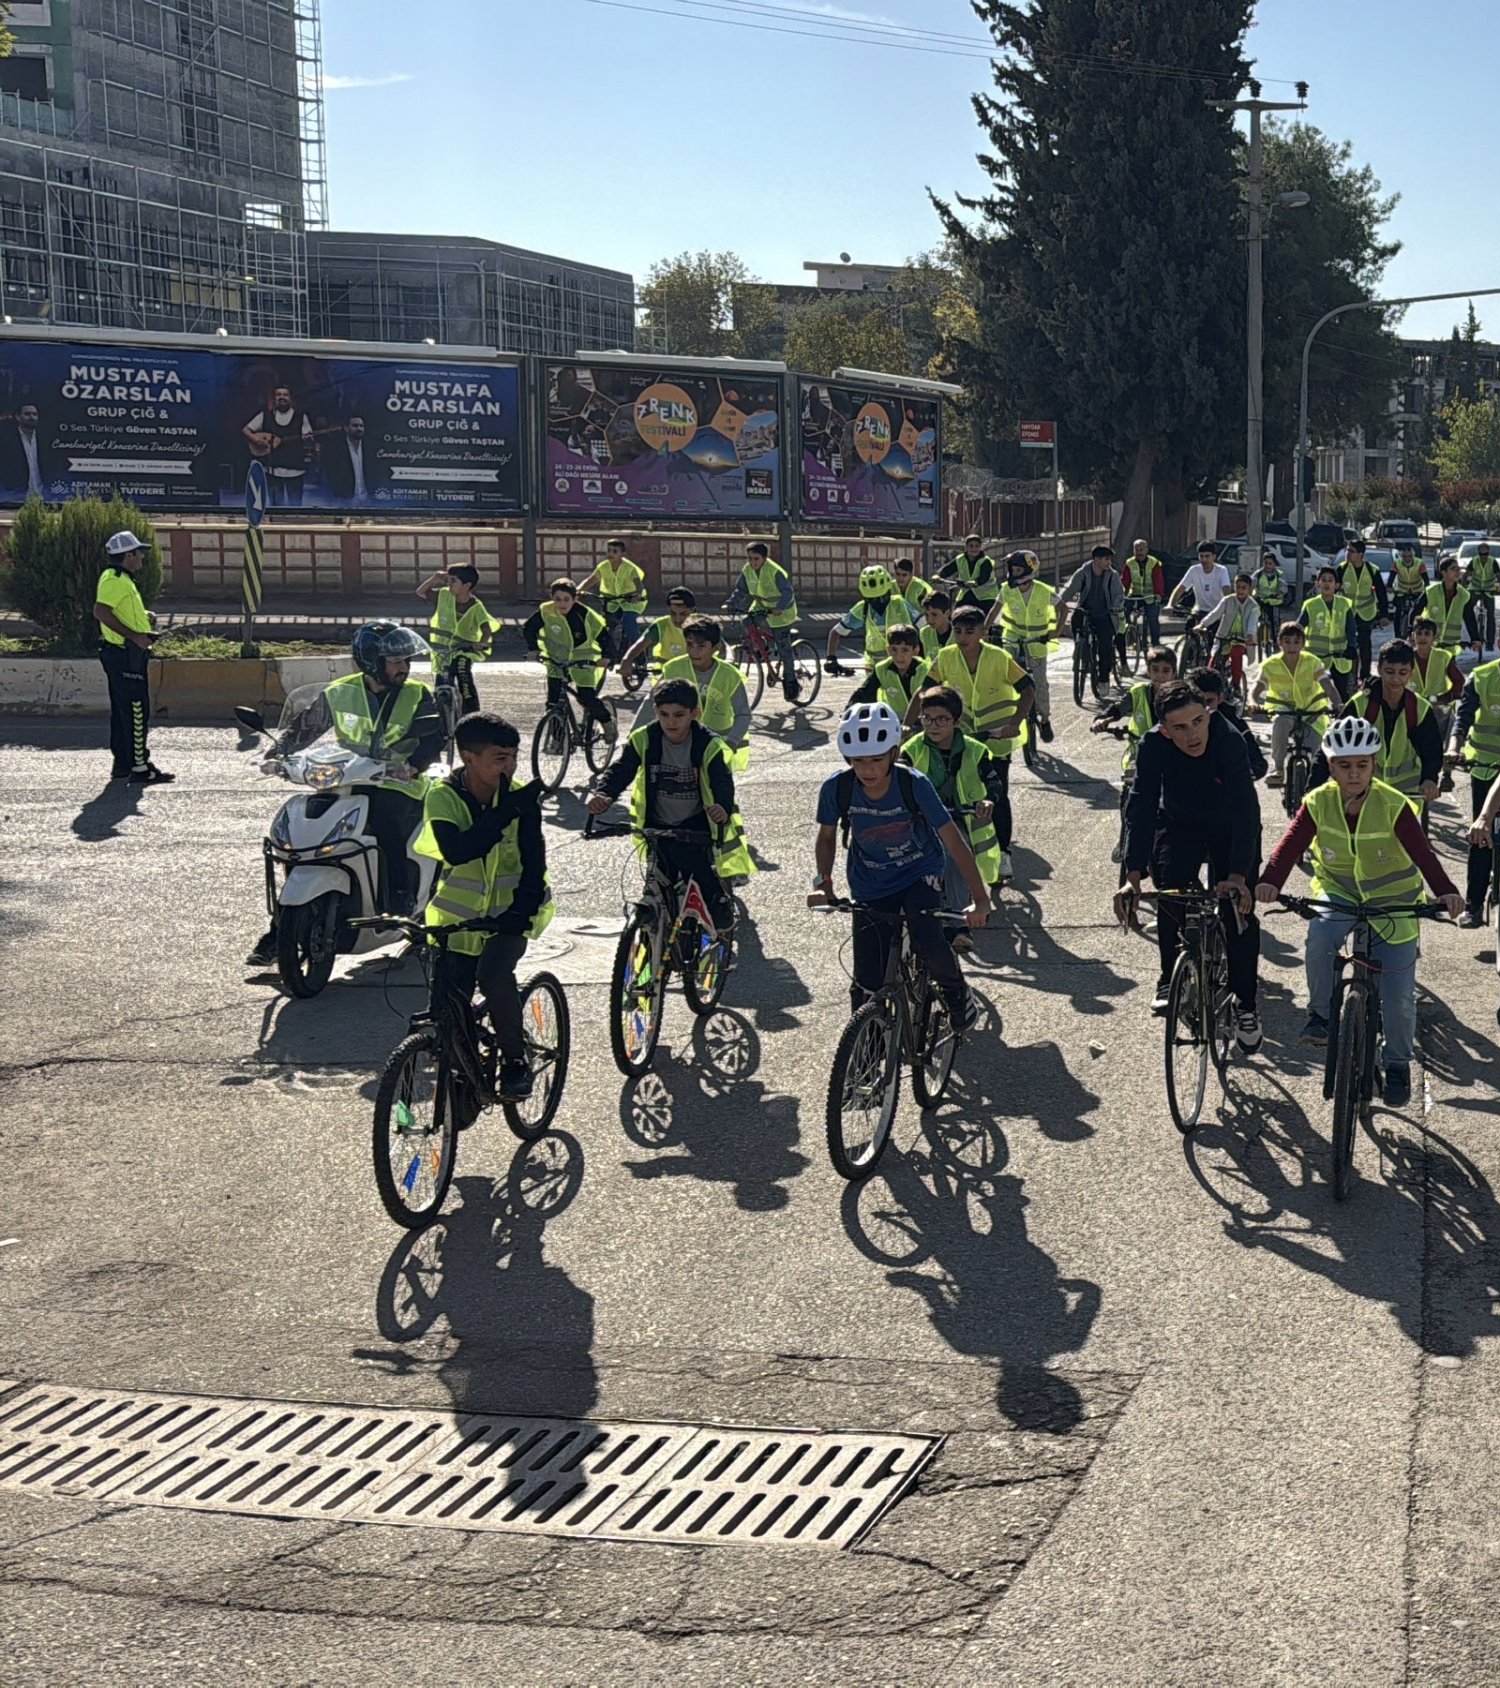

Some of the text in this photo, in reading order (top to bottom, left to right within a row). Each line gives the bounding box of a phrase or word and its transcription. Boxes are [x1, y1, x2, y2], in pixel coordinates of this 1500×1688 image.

[70, 365, 181, 385] MUSTAFA
[61, 380, 191, 403] ÖZARSLAN
[395, 380, 492, 398] MUSTAFA
[87, 406, 169, 420] GRUP ÇIĞ &
[386, 394, 500, 416] ÖZARSLAN
[638, 398, 696, 424] 7 RENK
[70, 424, 87, 432] Ses
[90, 423, 124, 434] Türkiye
[126, 425, 156, 434] Güven
[159, 426, 197, 436] TAŞTAN
[408, 419, 480, 431] GRUP ÇIĞ &
[865, 415, 890, 439] RENK
[411, 435, 440, 444] Türkiye
[442, 436, 469, 445] Güven
[471, 437, 505, 446] TAŞTAN
